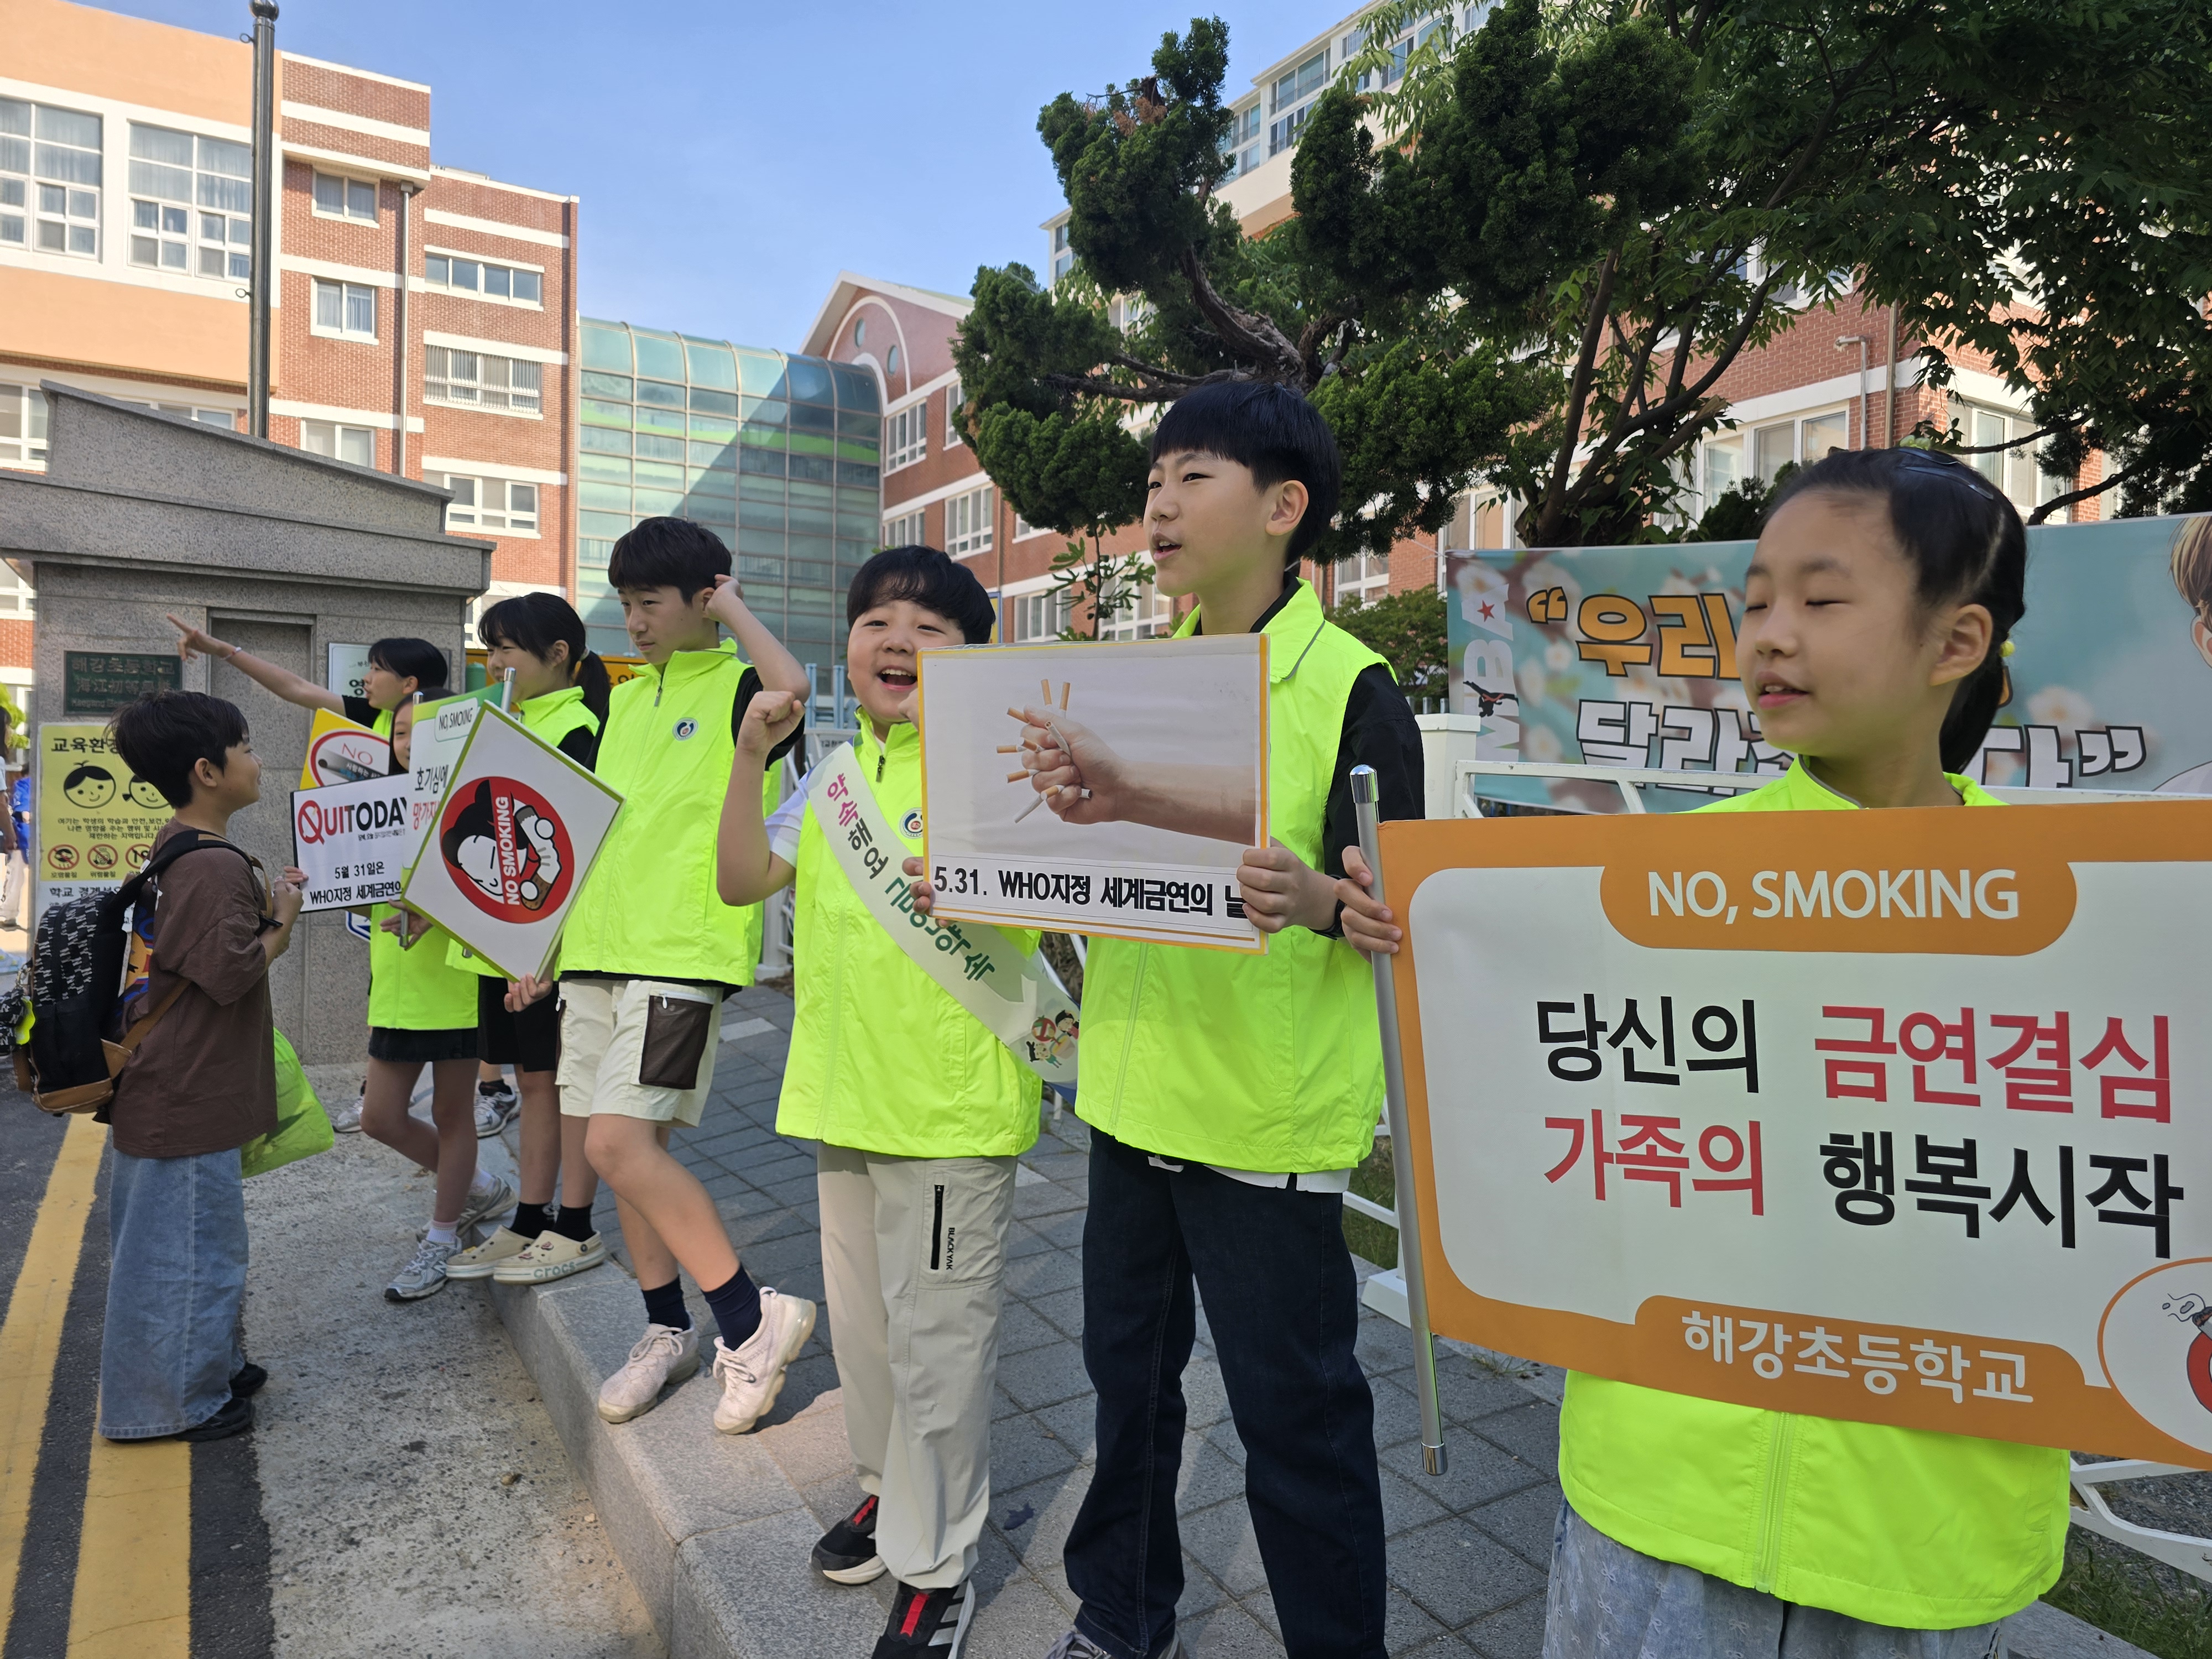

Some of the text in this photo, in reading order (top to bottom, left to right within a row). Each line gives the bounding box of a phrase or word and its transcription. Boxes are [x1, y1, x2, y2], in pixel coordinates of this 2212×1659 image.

[439, 708, 473, 732] NO, SMOKING
[342, 743, 373, 765] NO
[415, 764, 449, 794] 호기심에
[827, 772, 889, 880] 약속해요
[335, 862, 385, 879] 5월 31일은
[495, 796, 520, 905] NO SMOKING
[49, 886, 74, 898] 학교
[310, 886, 352, 905] WHO지정
[934, 866, 988, 896] 5.31.
[998, 870, 1091, 905] WHO지정
[1100, 877, 1213, 916] 세계금연의
[1648, 868, 2020, 925] NO, SMOKING
[1536, 993, 2172, 1124] 당신의 금연결심
[1543, 1108, 2185, 1260] 가족의 행복시작
[533, 1261, 576, 1279] crocs
[946, 1227, 956, 1270] BLACKYAK
[1681, 1310, 2034, 1405] 해강초등학교
